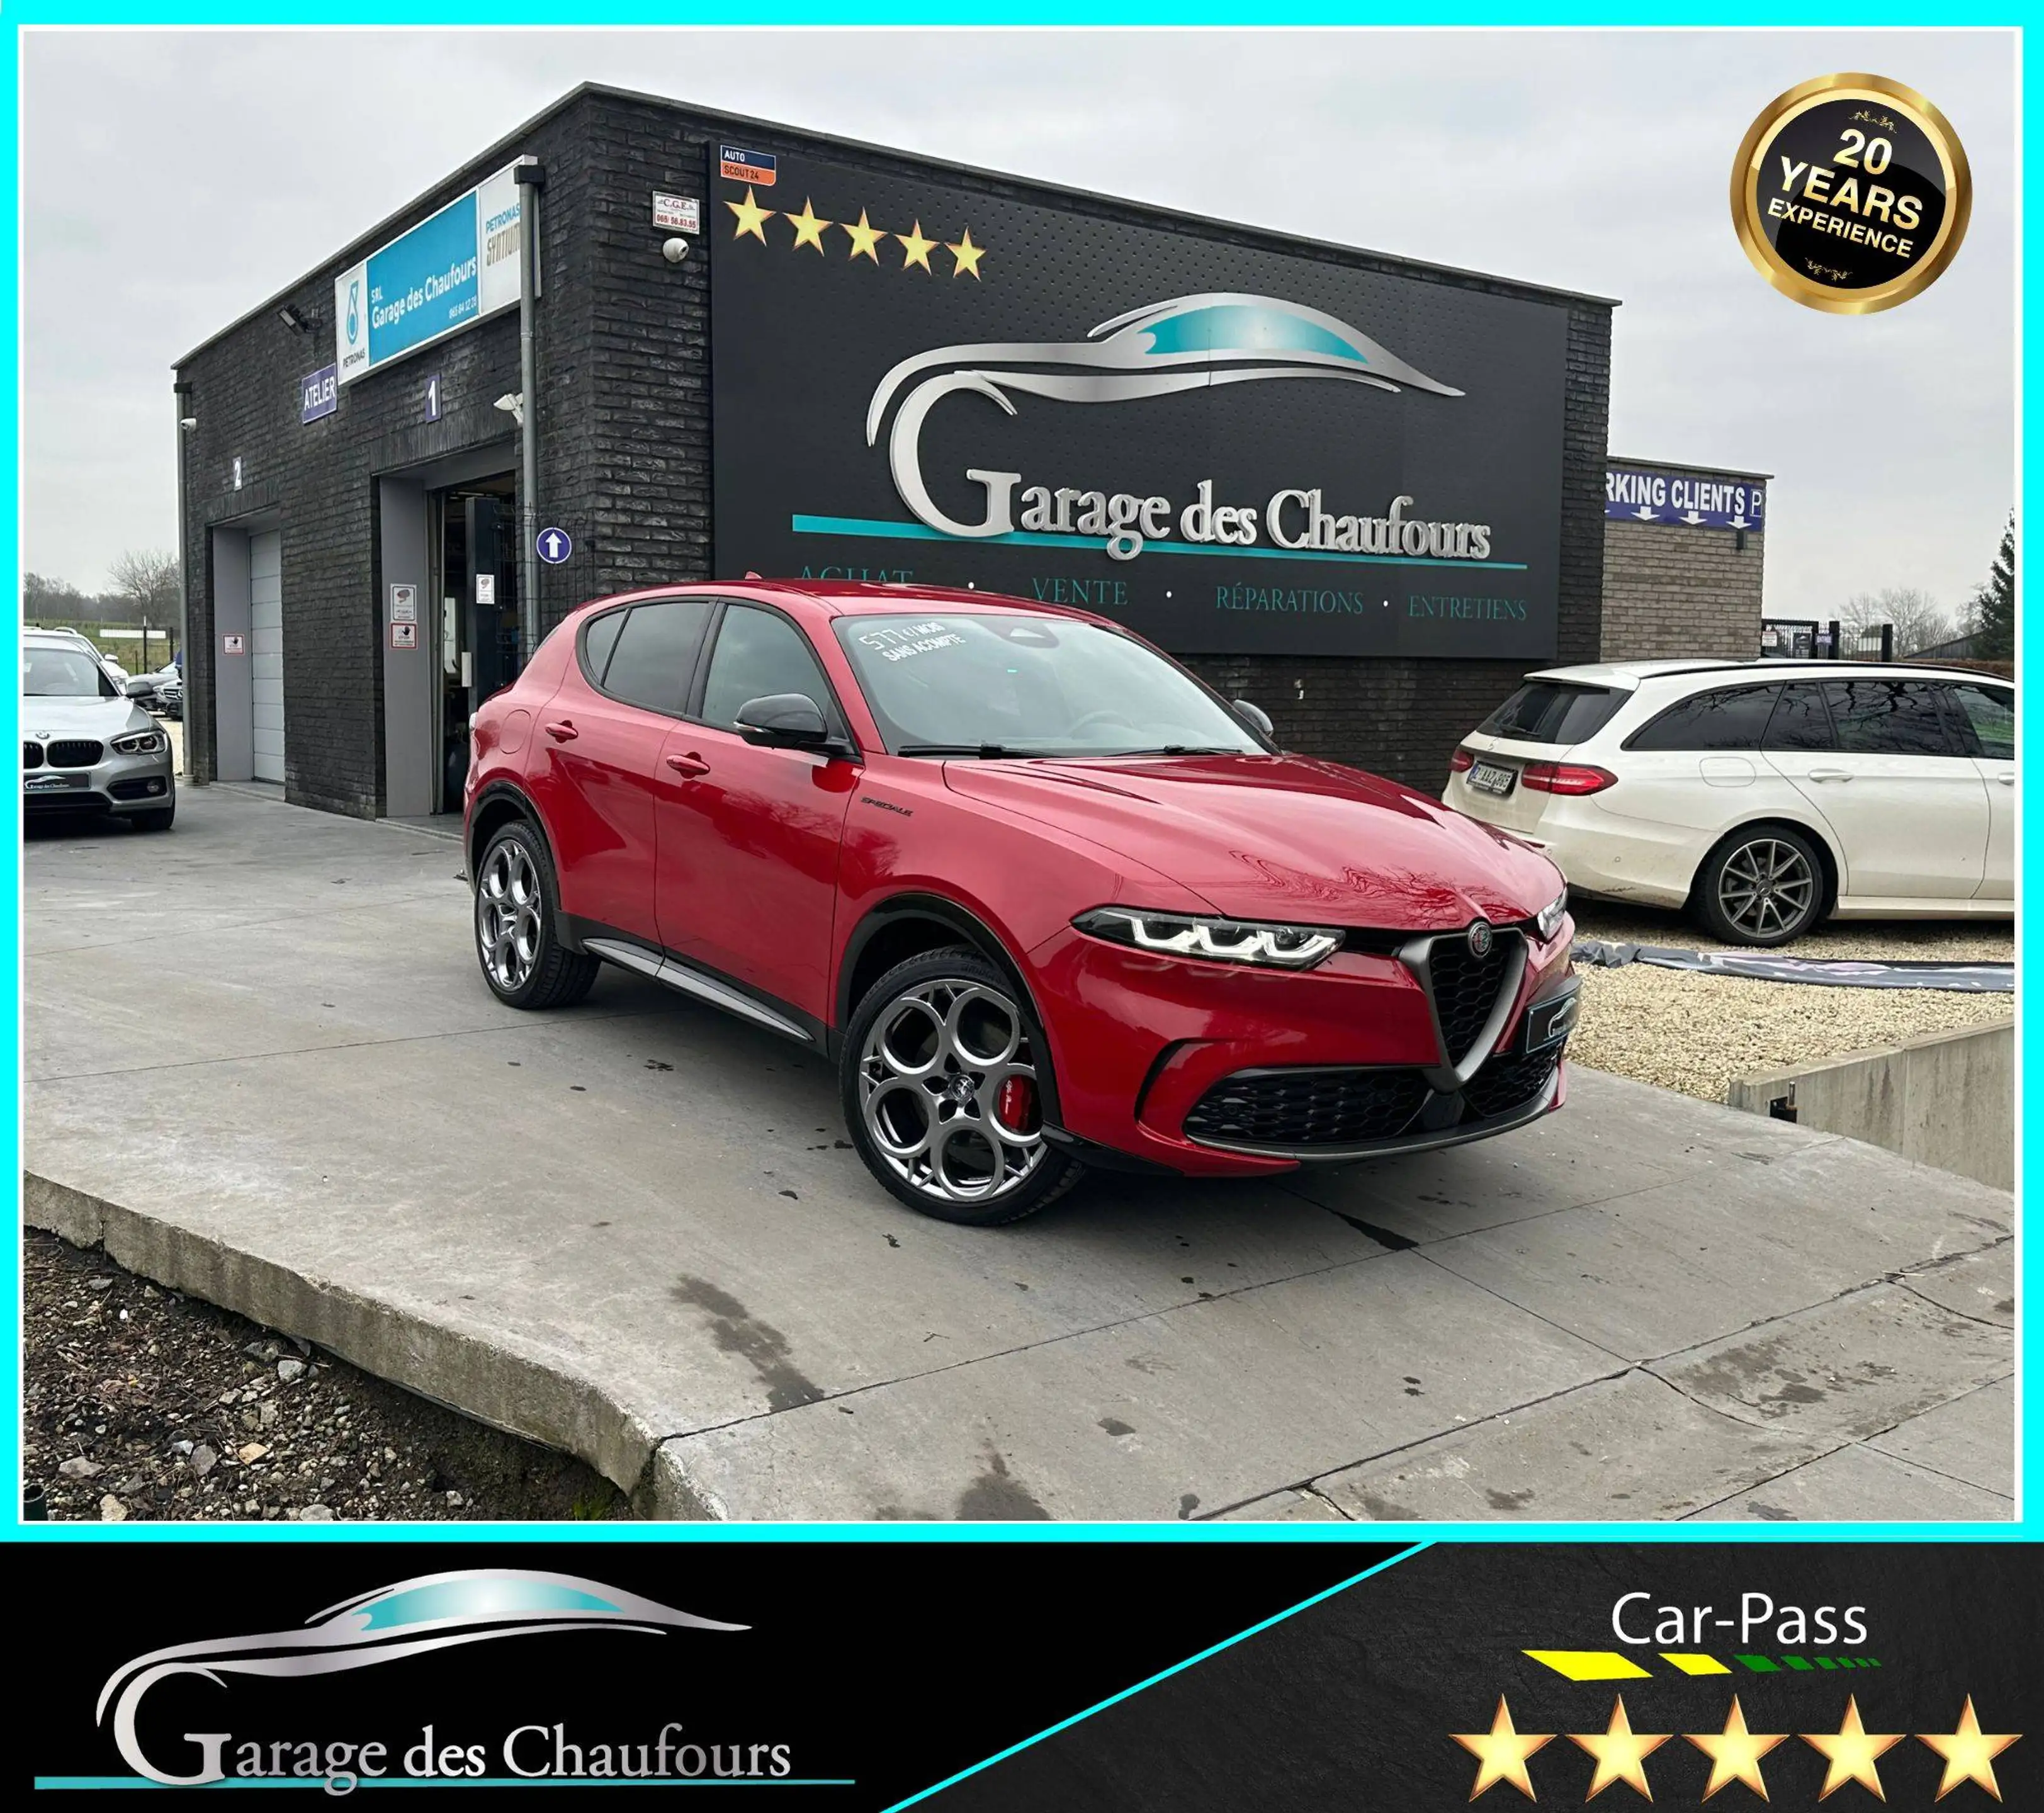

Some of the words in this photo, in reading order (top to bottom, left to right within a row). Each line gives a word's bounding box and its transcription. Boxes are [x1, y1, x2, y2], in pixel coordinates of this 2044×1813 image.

[724, 150, 745, 162] AUTO
[485, 203, 521, 235] PETRONAS
[371, 285, 383, 304] SRL
[372, 298, 406, 329] Garage
[407, 283, 424, 312] des
[425, 256, 477, 301] Chaufours
[342, 347, 366, 368] PETRONAS
[304, 376, 336, 410] ATELIER
[428, 380, 437, 417] 1
[234, 461, 241, 487] 2
[889, 370, 1171, 560] Garage
[1180, 479, 1258, 546] des
[1266, 488, 1491, 560] Chaufours
[1671, 479, 1746, 515] CLIENTS
[1031, 577, 1128, 606] VENTE
[1216, 582, 1364, 615] RÉPARATIONS
[1408, 594, 1527, 621] ENTRETIENS
[858, 628, 908, 650] 577
